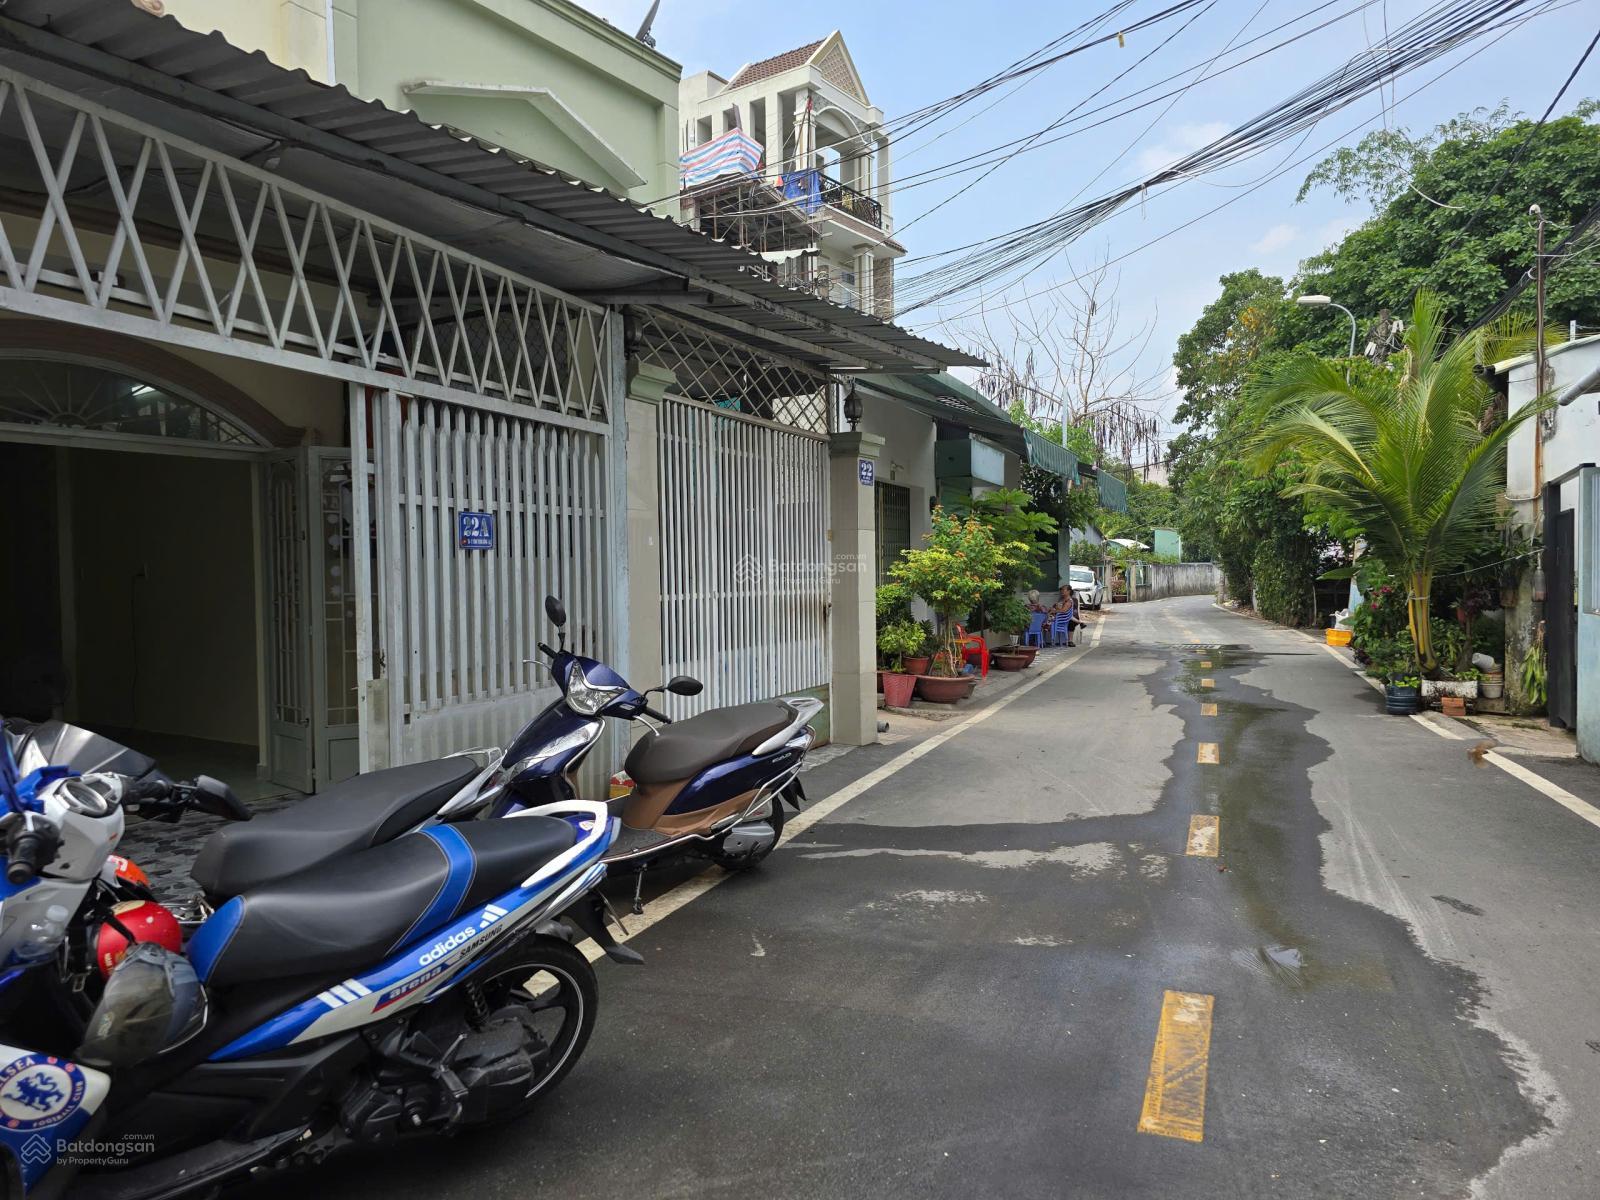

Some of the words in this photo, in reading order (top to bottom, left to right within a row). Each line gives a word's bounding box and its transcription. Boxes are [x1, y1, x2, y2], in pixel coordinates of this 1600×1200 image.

[861, 463, 872, 476] 22
[463, 516, 490, 537] 22A
[418, 926, 477, 967] adidas
[460, 924, 504, 957] SAMSUNG
[389, 966, 442, 999] arena
